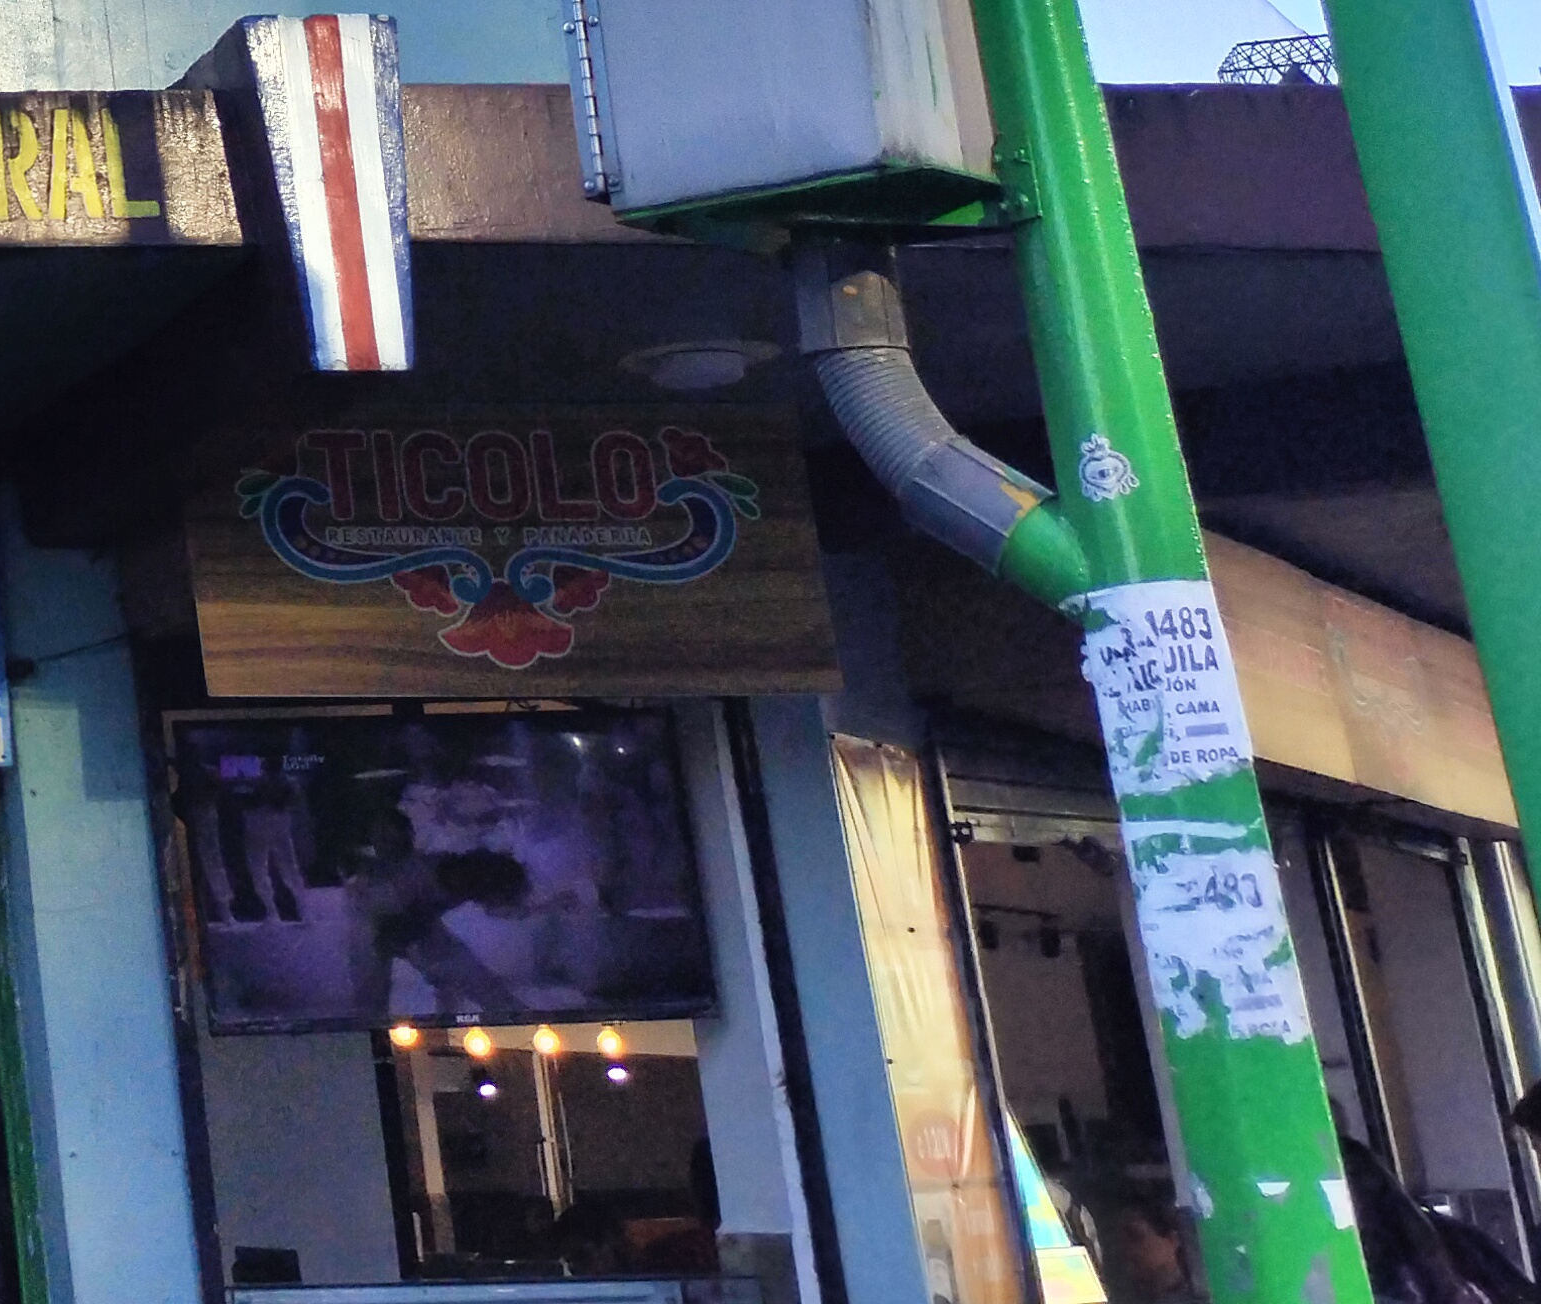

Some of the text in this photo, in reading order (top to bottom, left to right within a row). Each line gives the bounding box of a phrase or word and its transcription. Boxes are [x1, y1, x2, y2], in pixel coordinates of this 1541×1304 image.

[305, 429, 658, 522] TICOLO
[324, 526, 653, 547] RESTAURANTE Y PANADERIA
